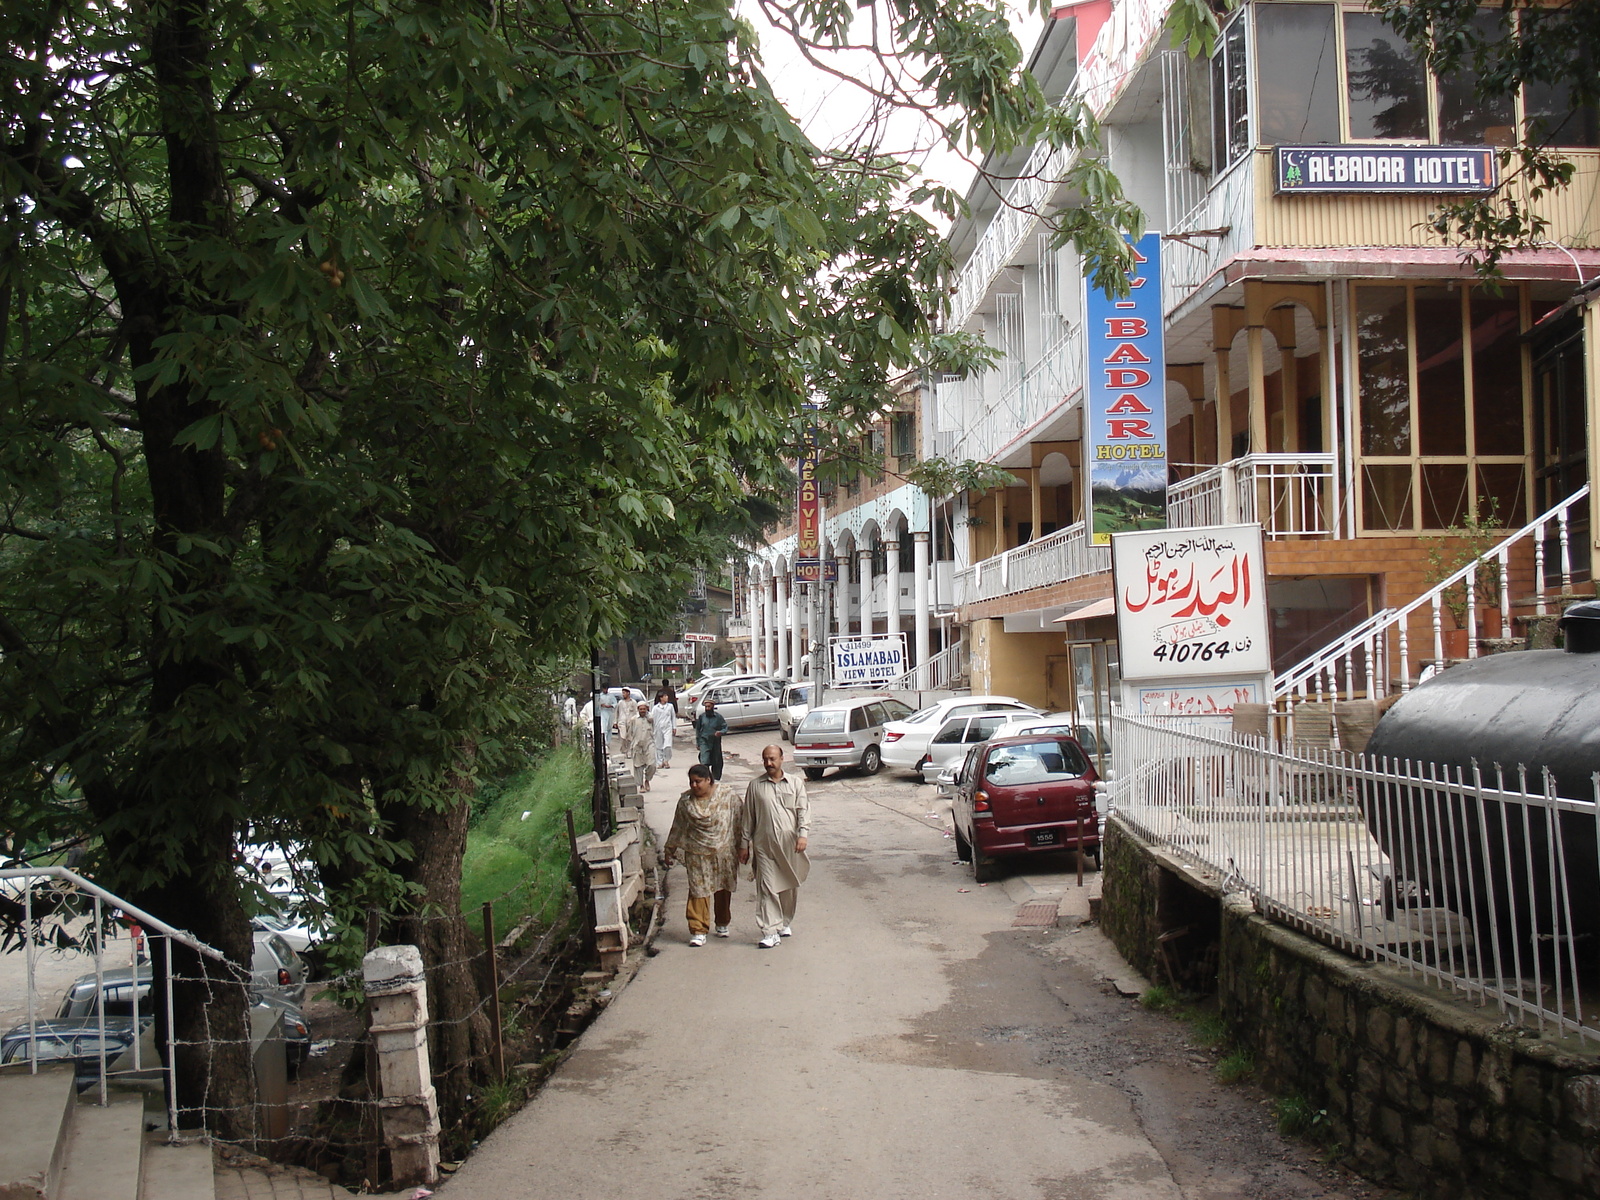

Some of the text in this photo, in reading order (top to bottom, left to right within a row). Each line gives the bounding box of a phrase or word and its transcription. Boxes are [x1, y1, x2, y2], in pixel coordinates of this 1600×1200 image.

[1308, 156, 1480, 185] AL-BADAR HOTEL
[1096, 444, 1165, 460] HOTEL
[801, 508, 818, 550] VIEW
[796, 565, 834, 576] HOTEL
[837, 649, 901, 667] ISLAMABAD
[1153, 641, 1230, 663] 410764
[843, 665, 897, 680] VIEW HOTEL
[1036, 834, 1053, 842] 1555
